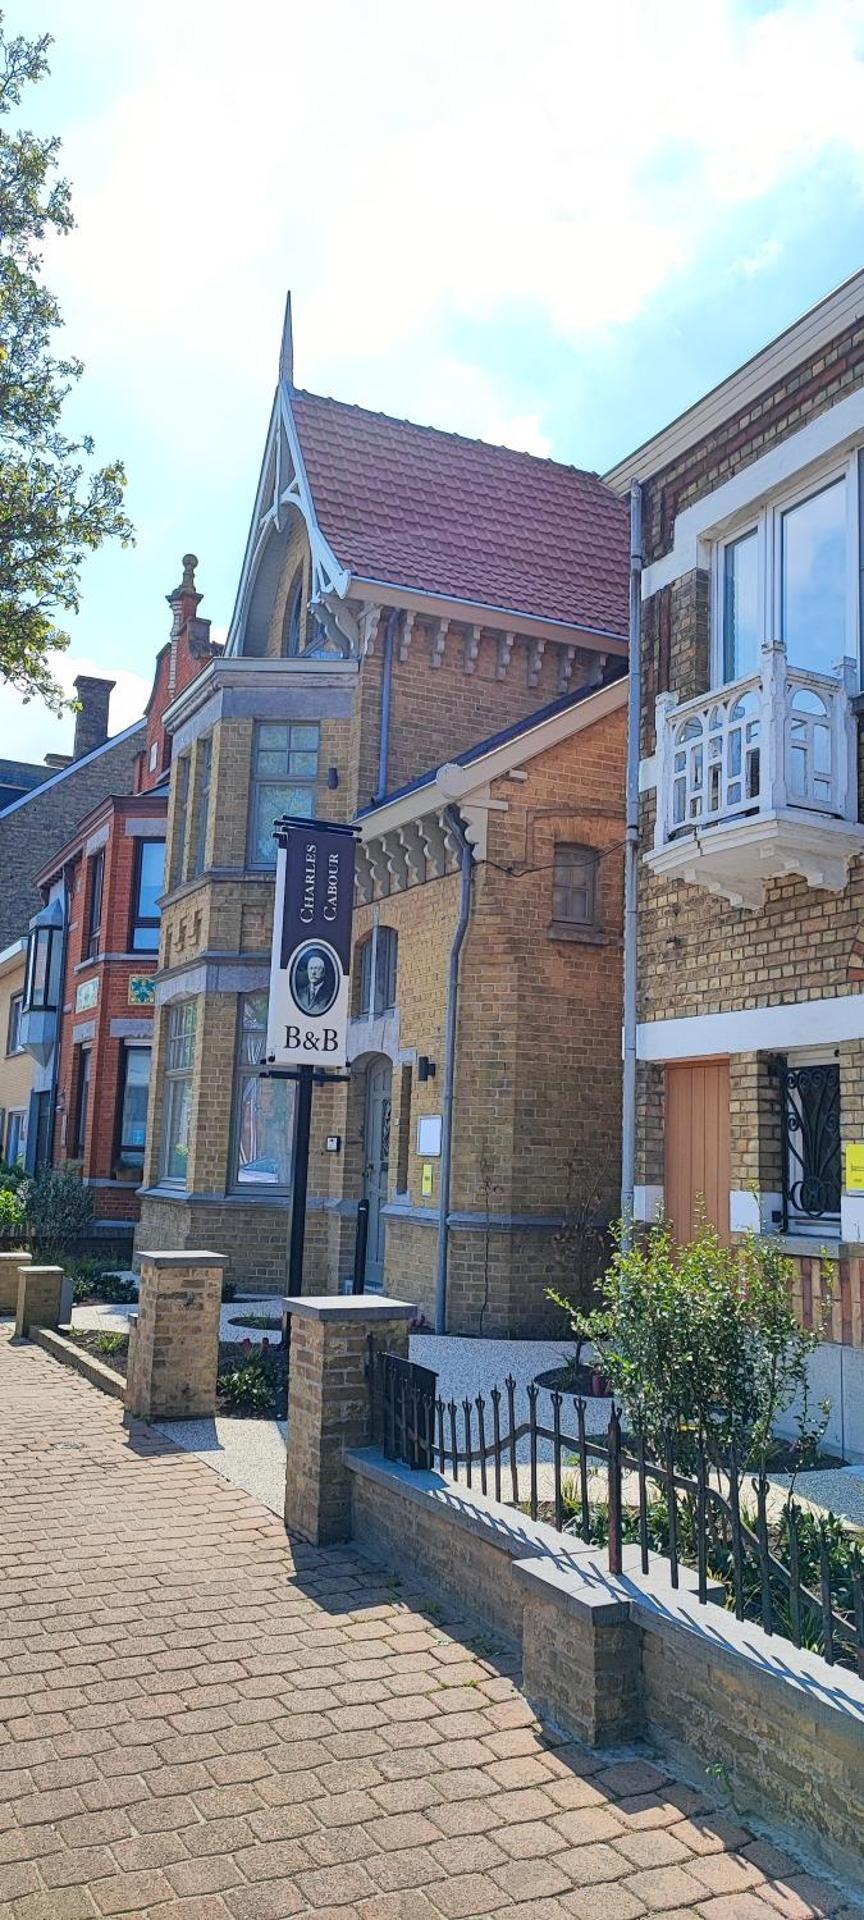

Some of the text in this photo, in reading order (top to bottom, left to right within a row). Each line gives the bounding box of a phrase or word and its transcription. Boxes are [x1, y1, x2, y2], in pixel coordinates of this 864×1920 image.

[300, 843, 317, 923] CHARLES
[323, 853, 339, 921] CABOUR
[284, 1025, 338, 1051] B&B
